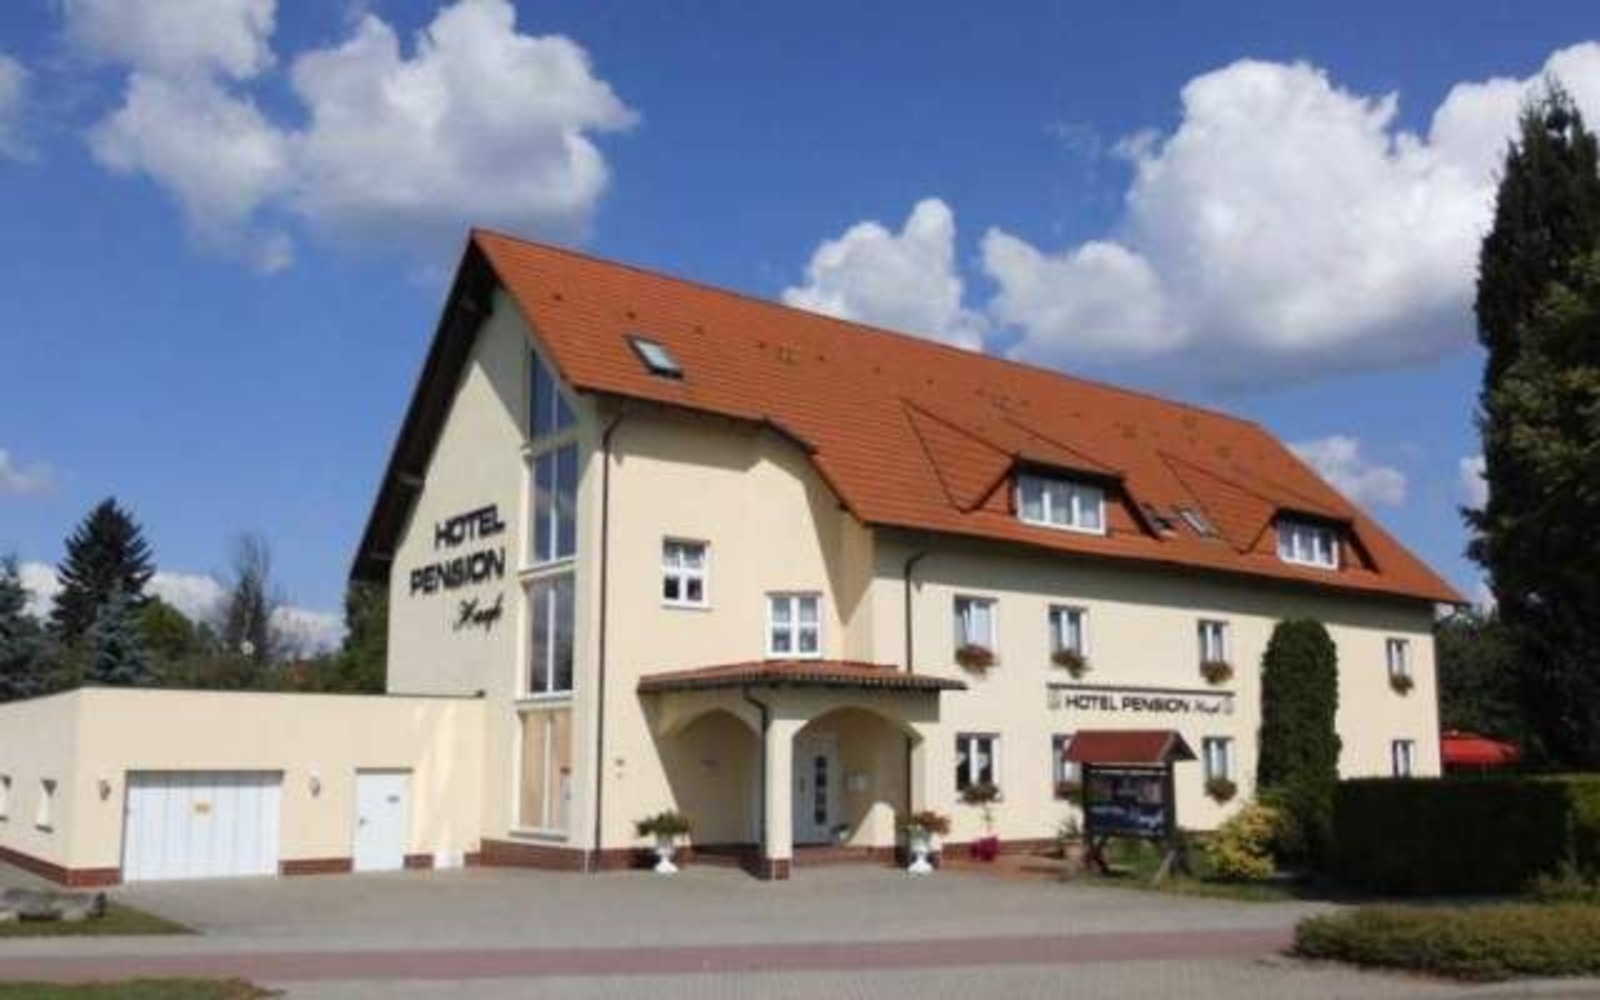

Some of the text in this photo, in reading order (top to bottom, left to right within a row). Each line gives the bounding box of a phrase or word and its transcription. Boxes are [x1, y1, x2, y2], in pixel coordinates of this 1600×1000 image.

[435, 503, 505, 550] HOTEL
[409, 546, 505, 597] PENSION
[1065, 694, 1118, 711] HOTEL
[1122, 696, 1190, 713] PENSION
